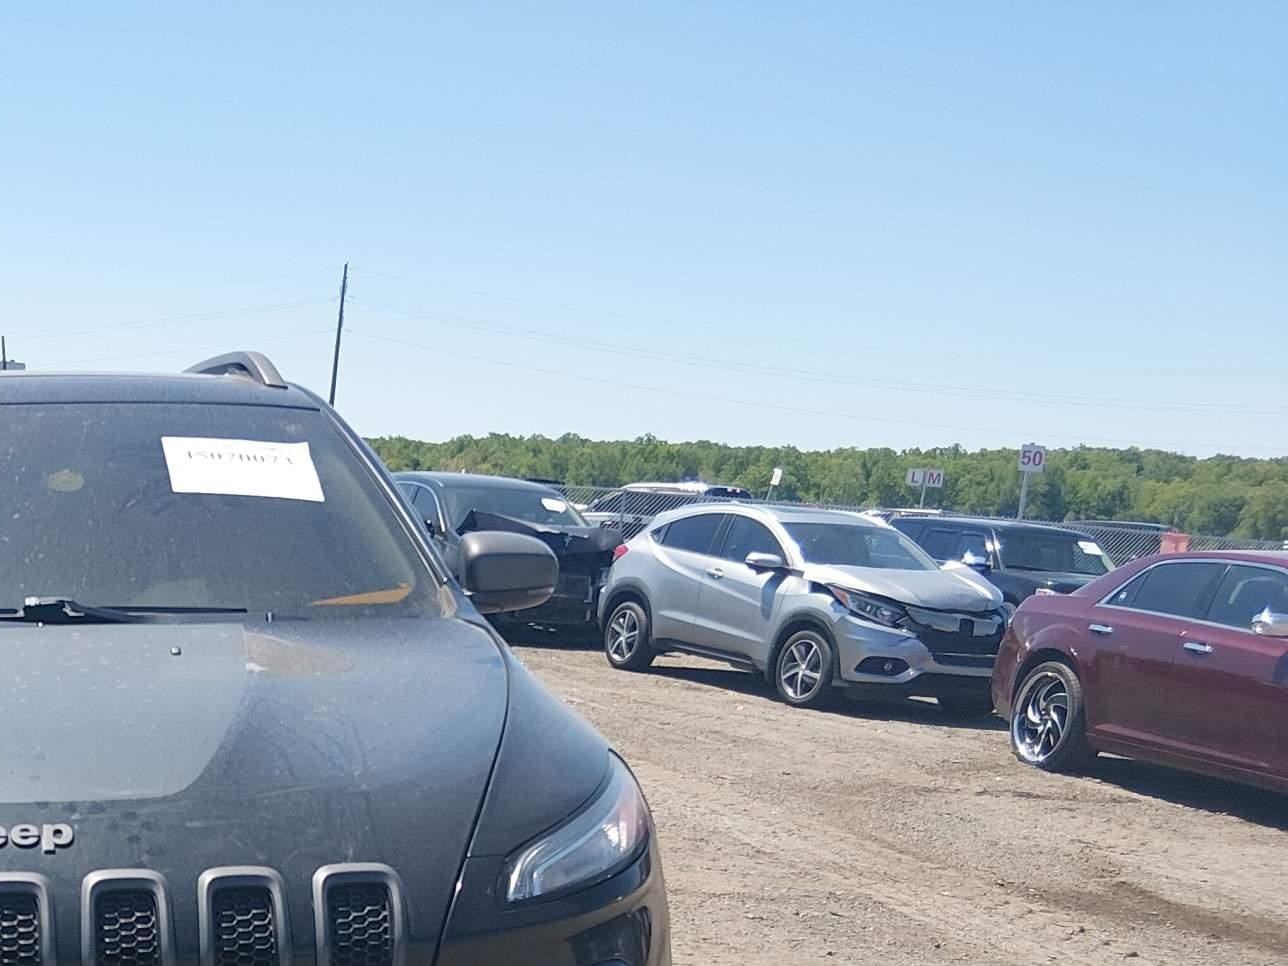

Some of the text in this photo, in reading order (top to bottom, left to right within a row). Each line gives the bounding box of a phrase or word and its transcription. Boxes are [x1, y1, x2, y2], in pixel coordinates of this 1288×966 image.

[1021, 451, 1043, 467] 50
[911, 471, 919, 484] L
[927, 472, 942, 485] M
